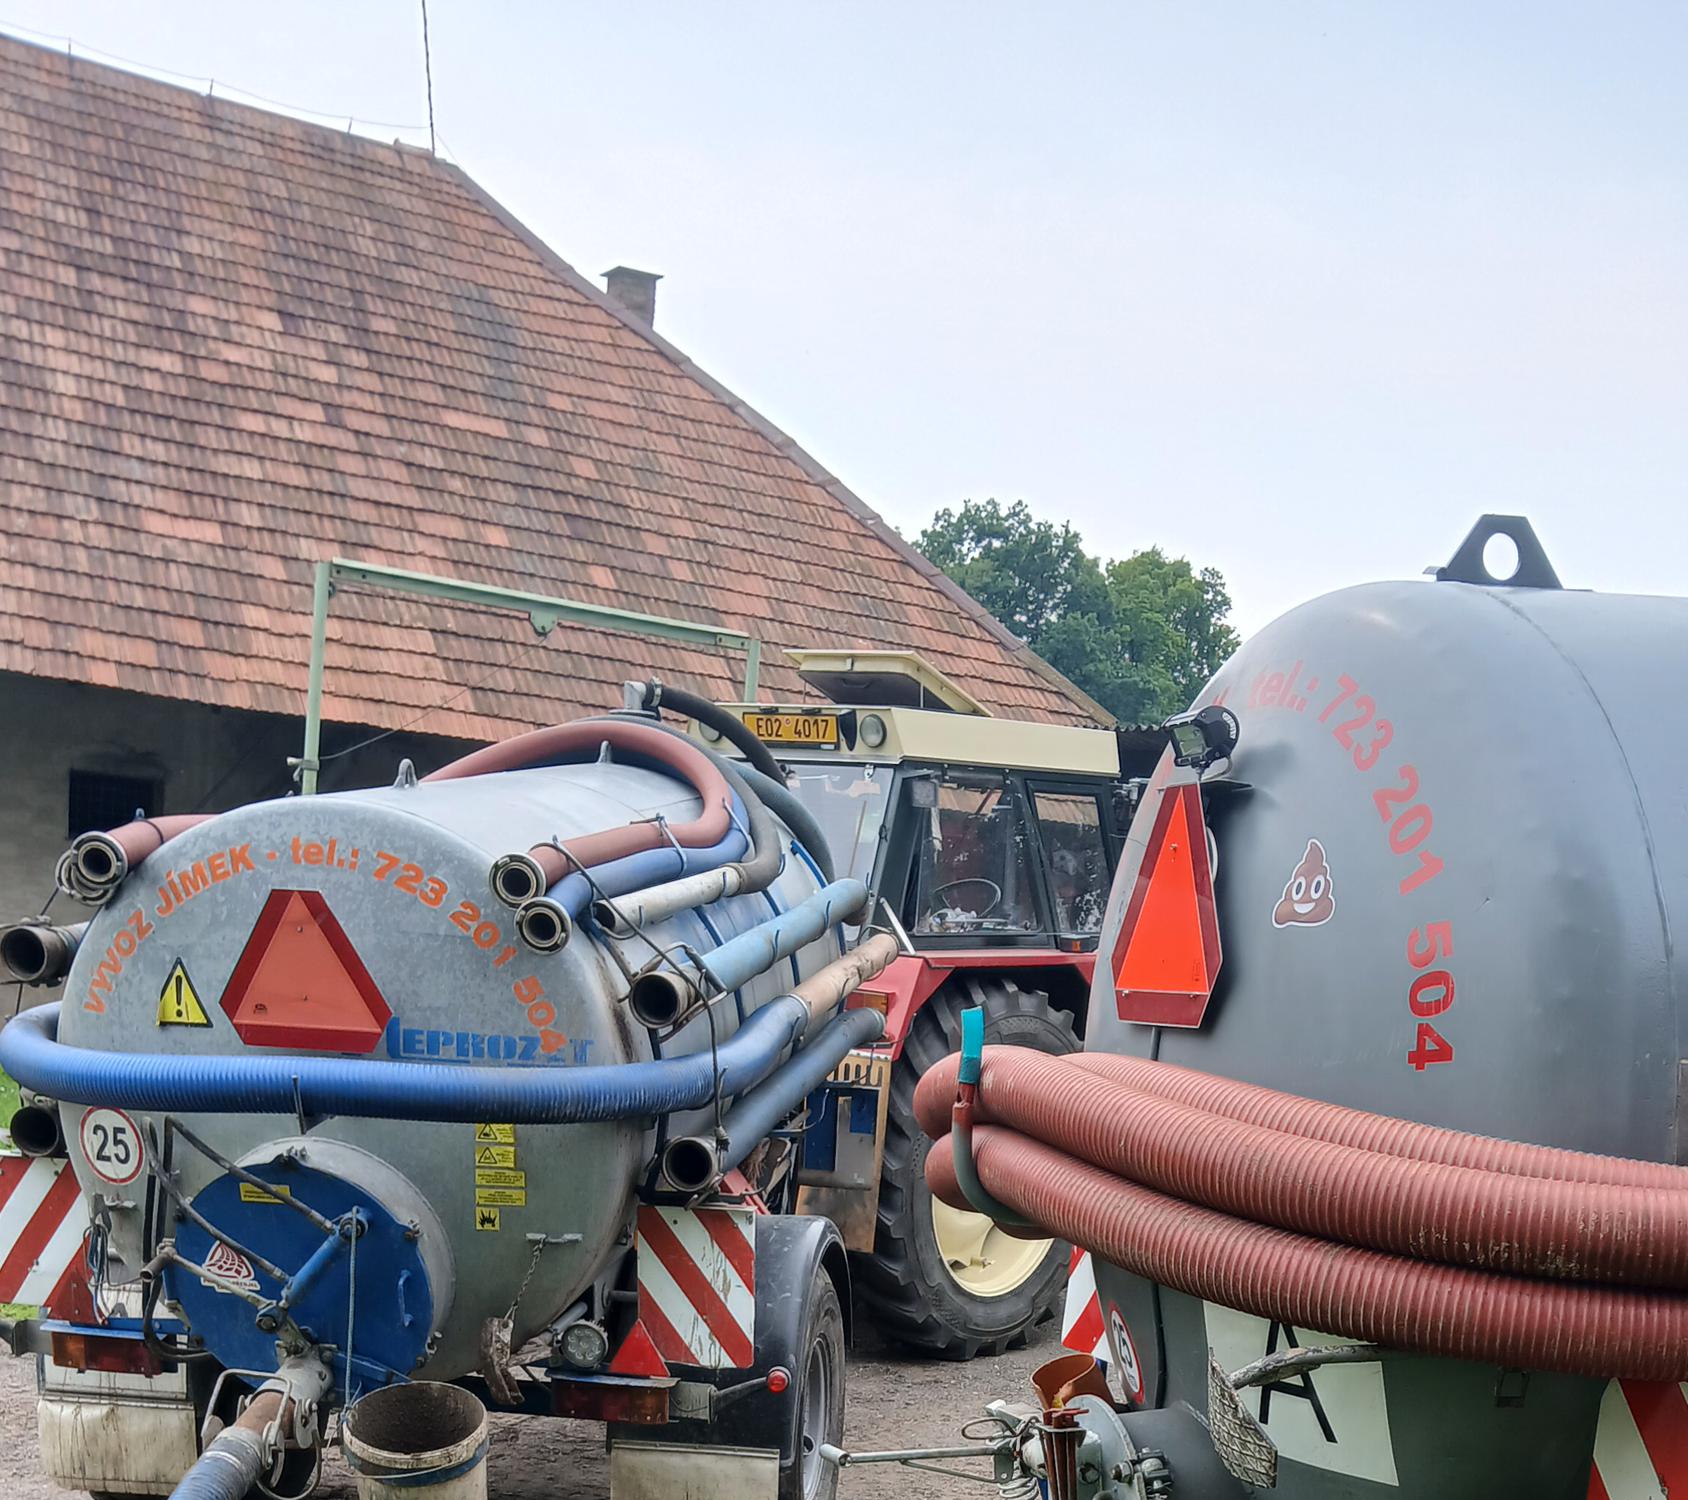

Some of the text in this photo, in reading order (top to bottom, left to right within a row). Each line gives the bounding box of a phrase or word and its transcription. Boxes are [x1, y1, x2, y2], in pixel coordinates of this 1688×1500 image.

[756, 717, 829, 739] E02 4017
[1318, 672, 1394, 772] 723
[1372, 764, 1444, 896] 201
[156, 843, 255, 917] JÍMEK
[291, 836, 359, 871] tel.:
[373, 851, 448, 908] 723
[449, 901, 517, 968] 201
[513, 976, 567, 1054] 504
[1406, 920, 1455, 1072] 504
[92, 1124, 131, 1164] 25
[1112, 1319, 1132, 1369] 25
[1258, 1319, 1338, 1444] A
